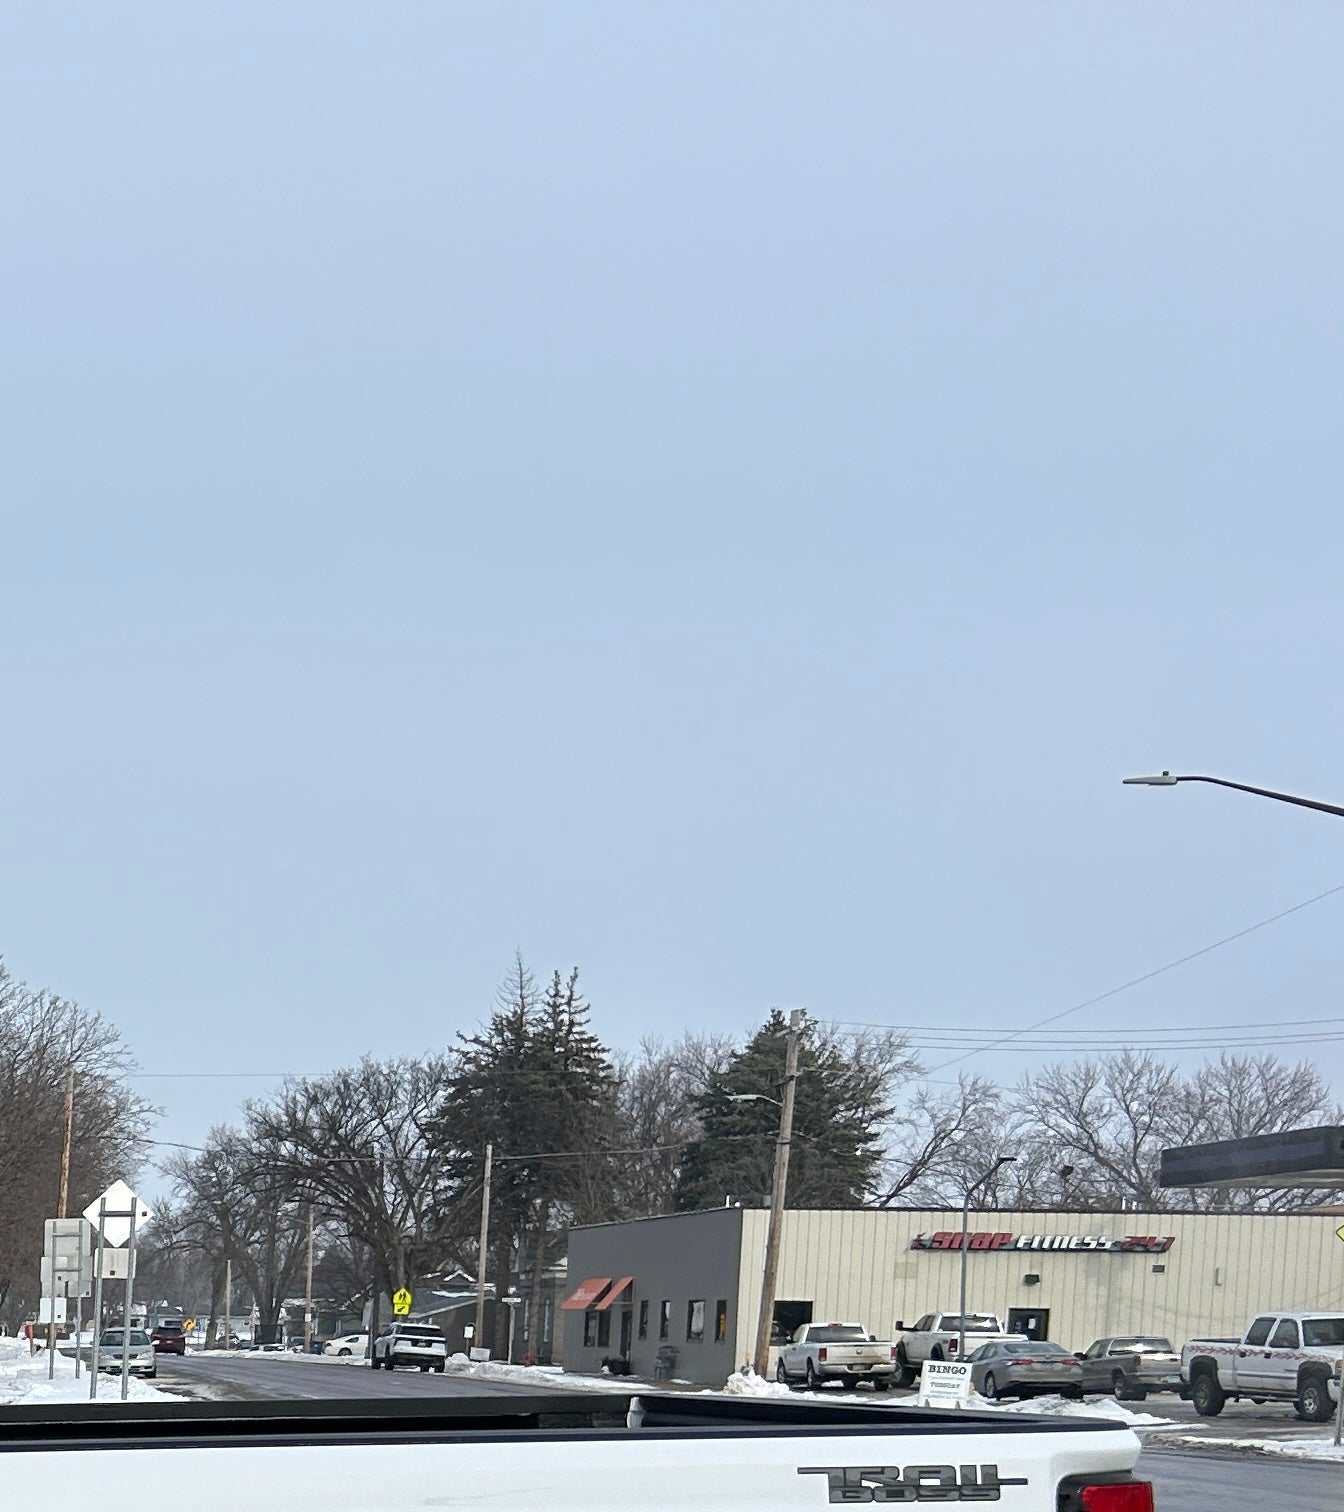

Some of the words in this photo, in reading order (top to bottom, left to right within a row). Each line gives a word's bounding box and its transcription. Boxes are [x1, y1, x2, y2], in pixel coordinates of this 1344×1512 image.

[1016, 1234, 1113, 1249] FITNESS
[928, 1364, 967, 1375] BINGO
[797, 1464, 1028, 1488] TRAIL
[829, 1485, 1001, 1504] BOSS
